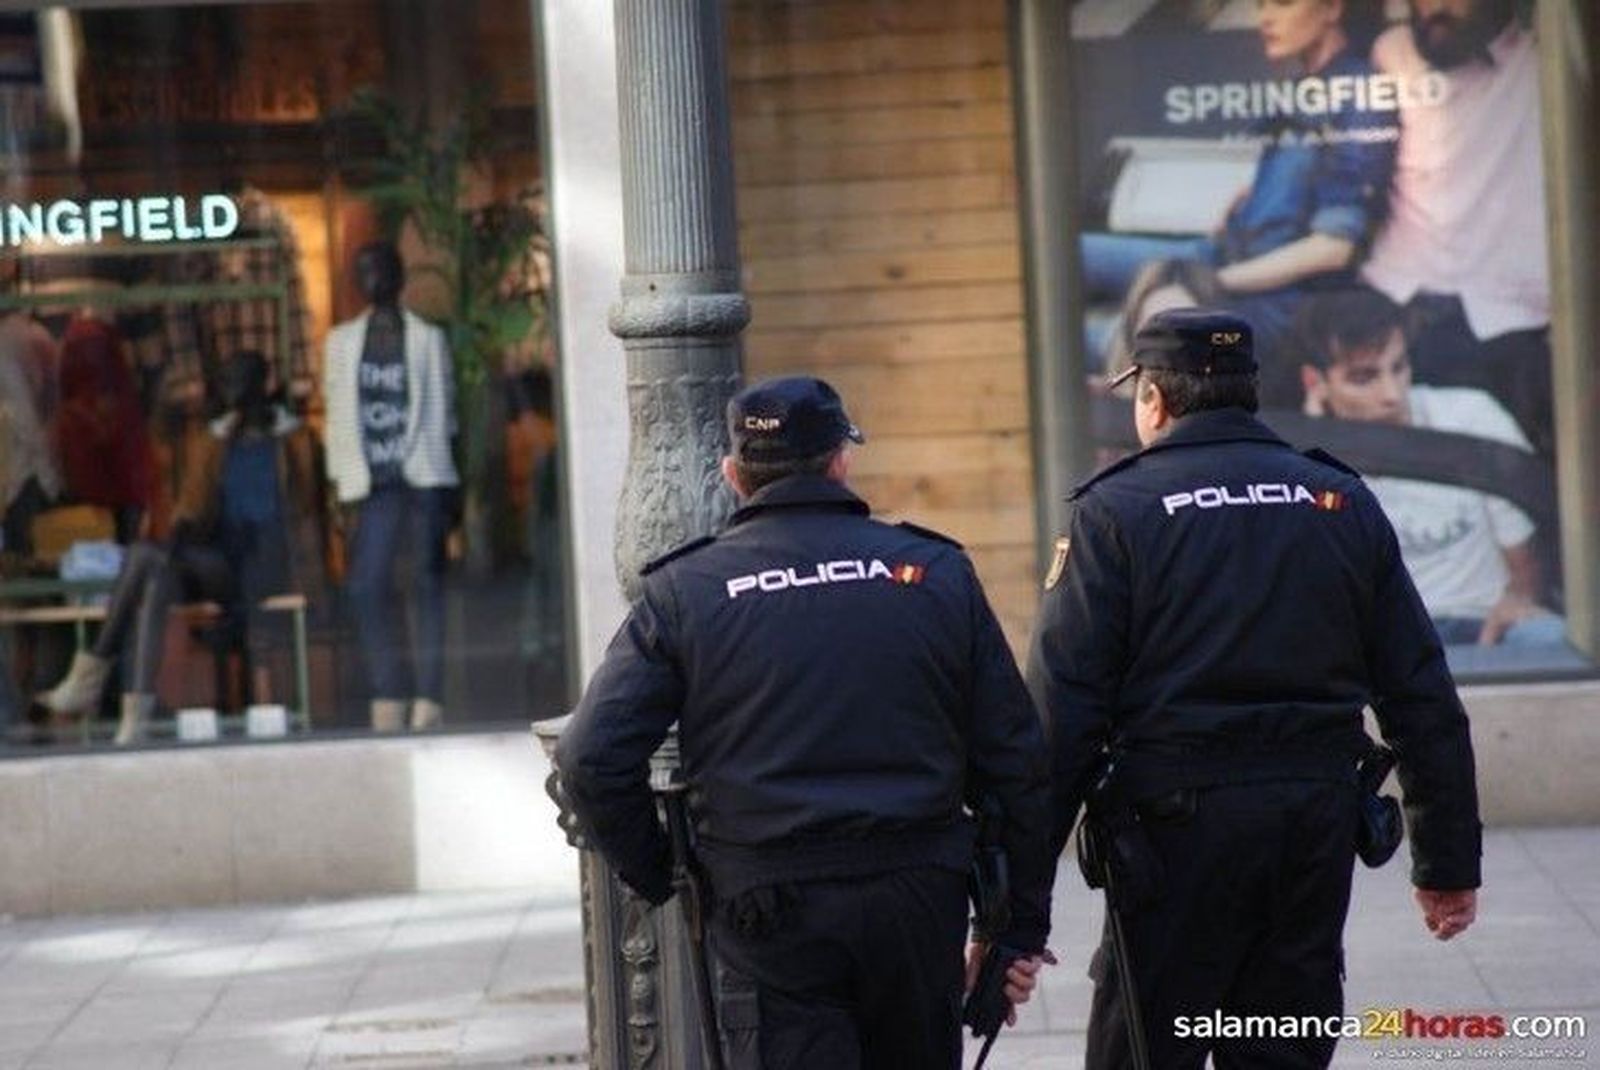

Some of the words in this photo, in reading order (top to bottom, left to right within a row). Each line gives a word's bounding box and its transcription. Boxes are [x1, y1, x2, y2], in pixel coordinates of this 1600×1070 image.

[1164, 70, 1450, 124] SPRINGFIELD
[744, 416, 780, 431] CNP
[1162, 483, 1317, 516] POLICIA
[726, 558, 893, 599] POLICIA
